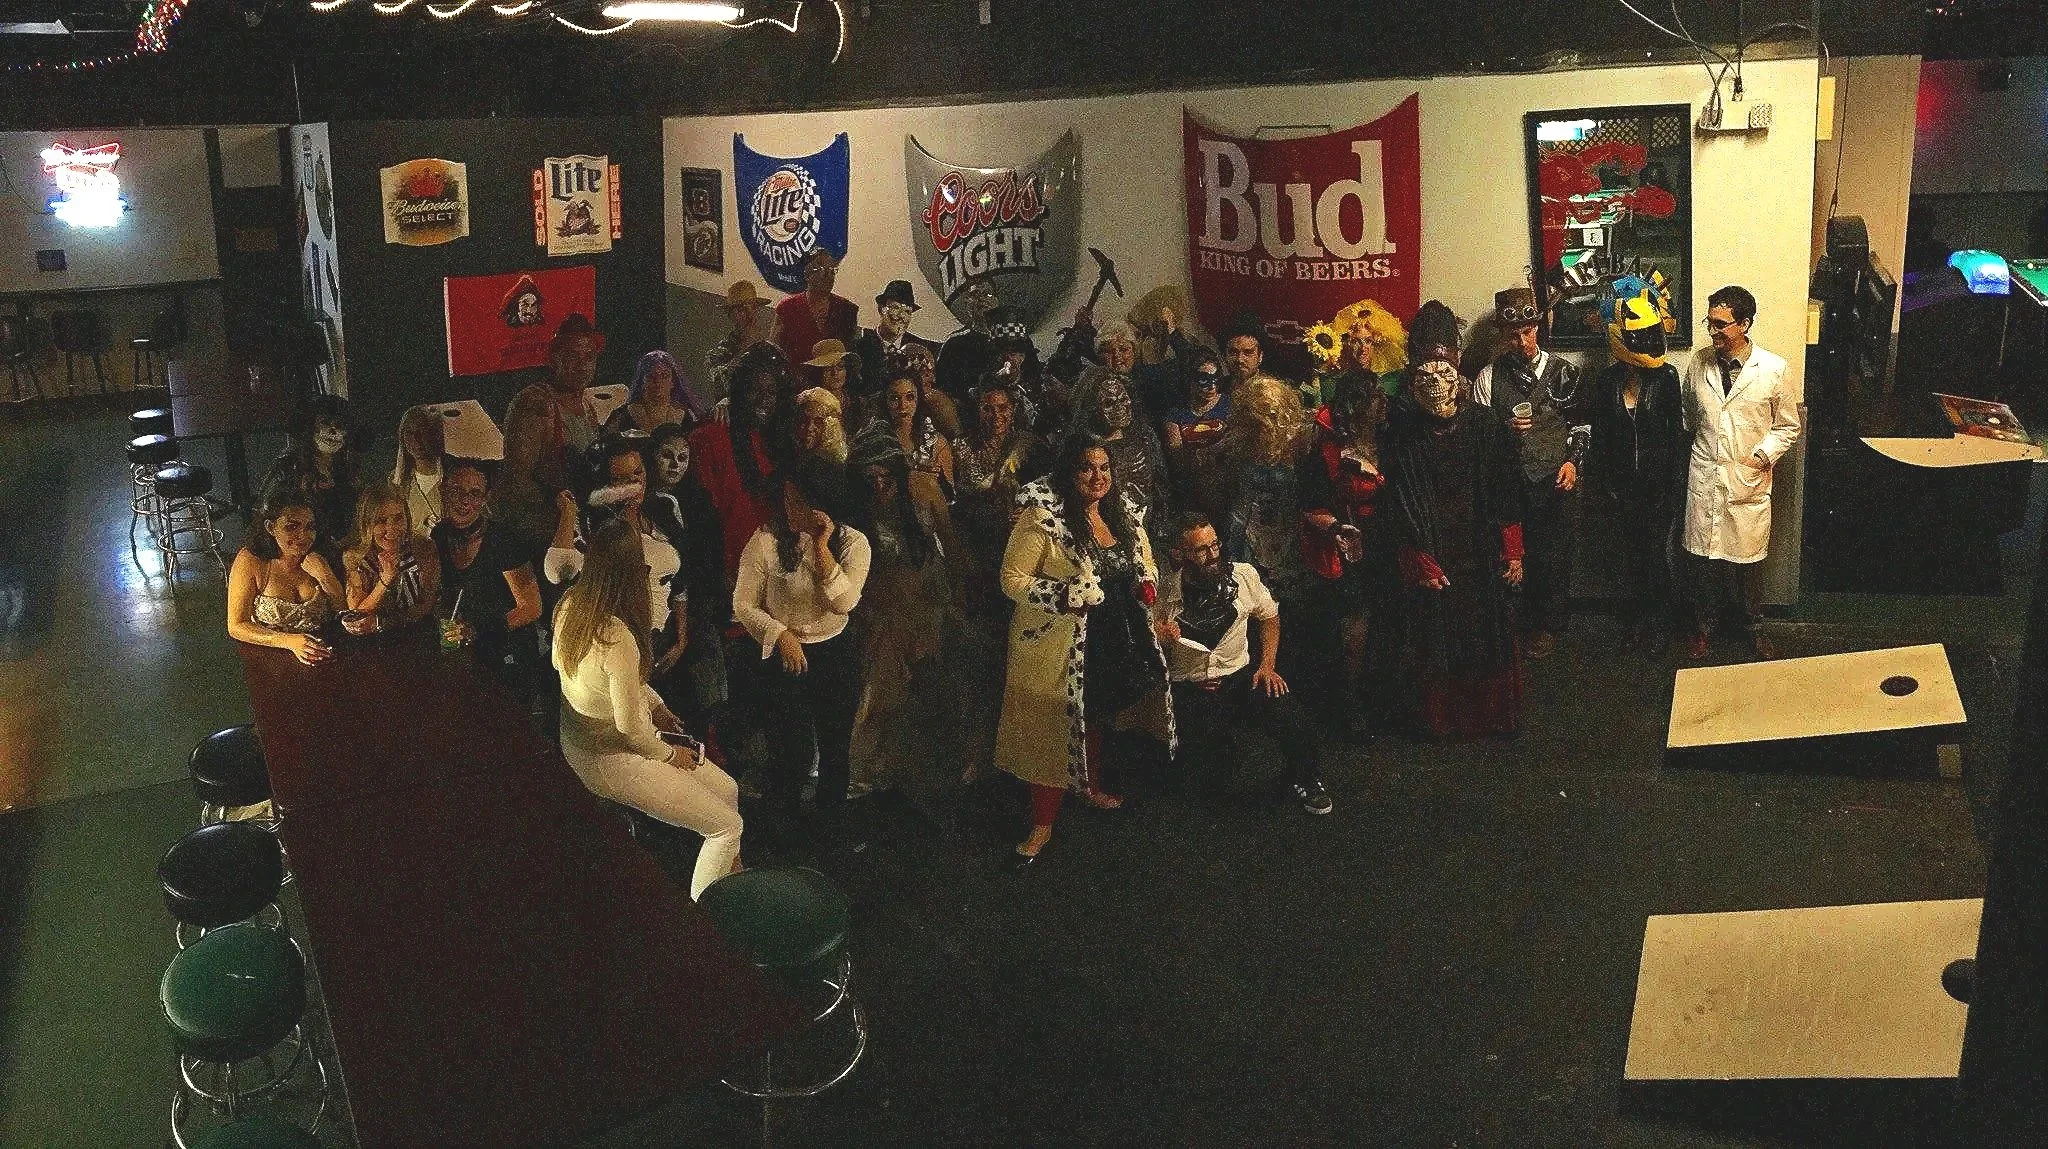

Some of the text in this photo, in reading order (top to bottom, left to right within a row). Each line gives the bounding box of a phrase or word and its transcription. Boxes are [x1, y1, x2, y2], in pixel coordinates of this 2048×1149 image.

[551, 162, 602, 202] Lite
[1198, 139, 1397, 259] Bud
[389, 198, 465, 216] Budweiser
[401, 212, 454, 224] SELECT
[532, 169, 546, 246] SOLD
[761, 187, 803, 226] Lite
[922, 169, 1046, 253] Coors
[756, 226, 817, 267] RACING
[939, 226, 1040, 301] LIGHT
[1199, 251, 1392, 281] KING OF BEERS
